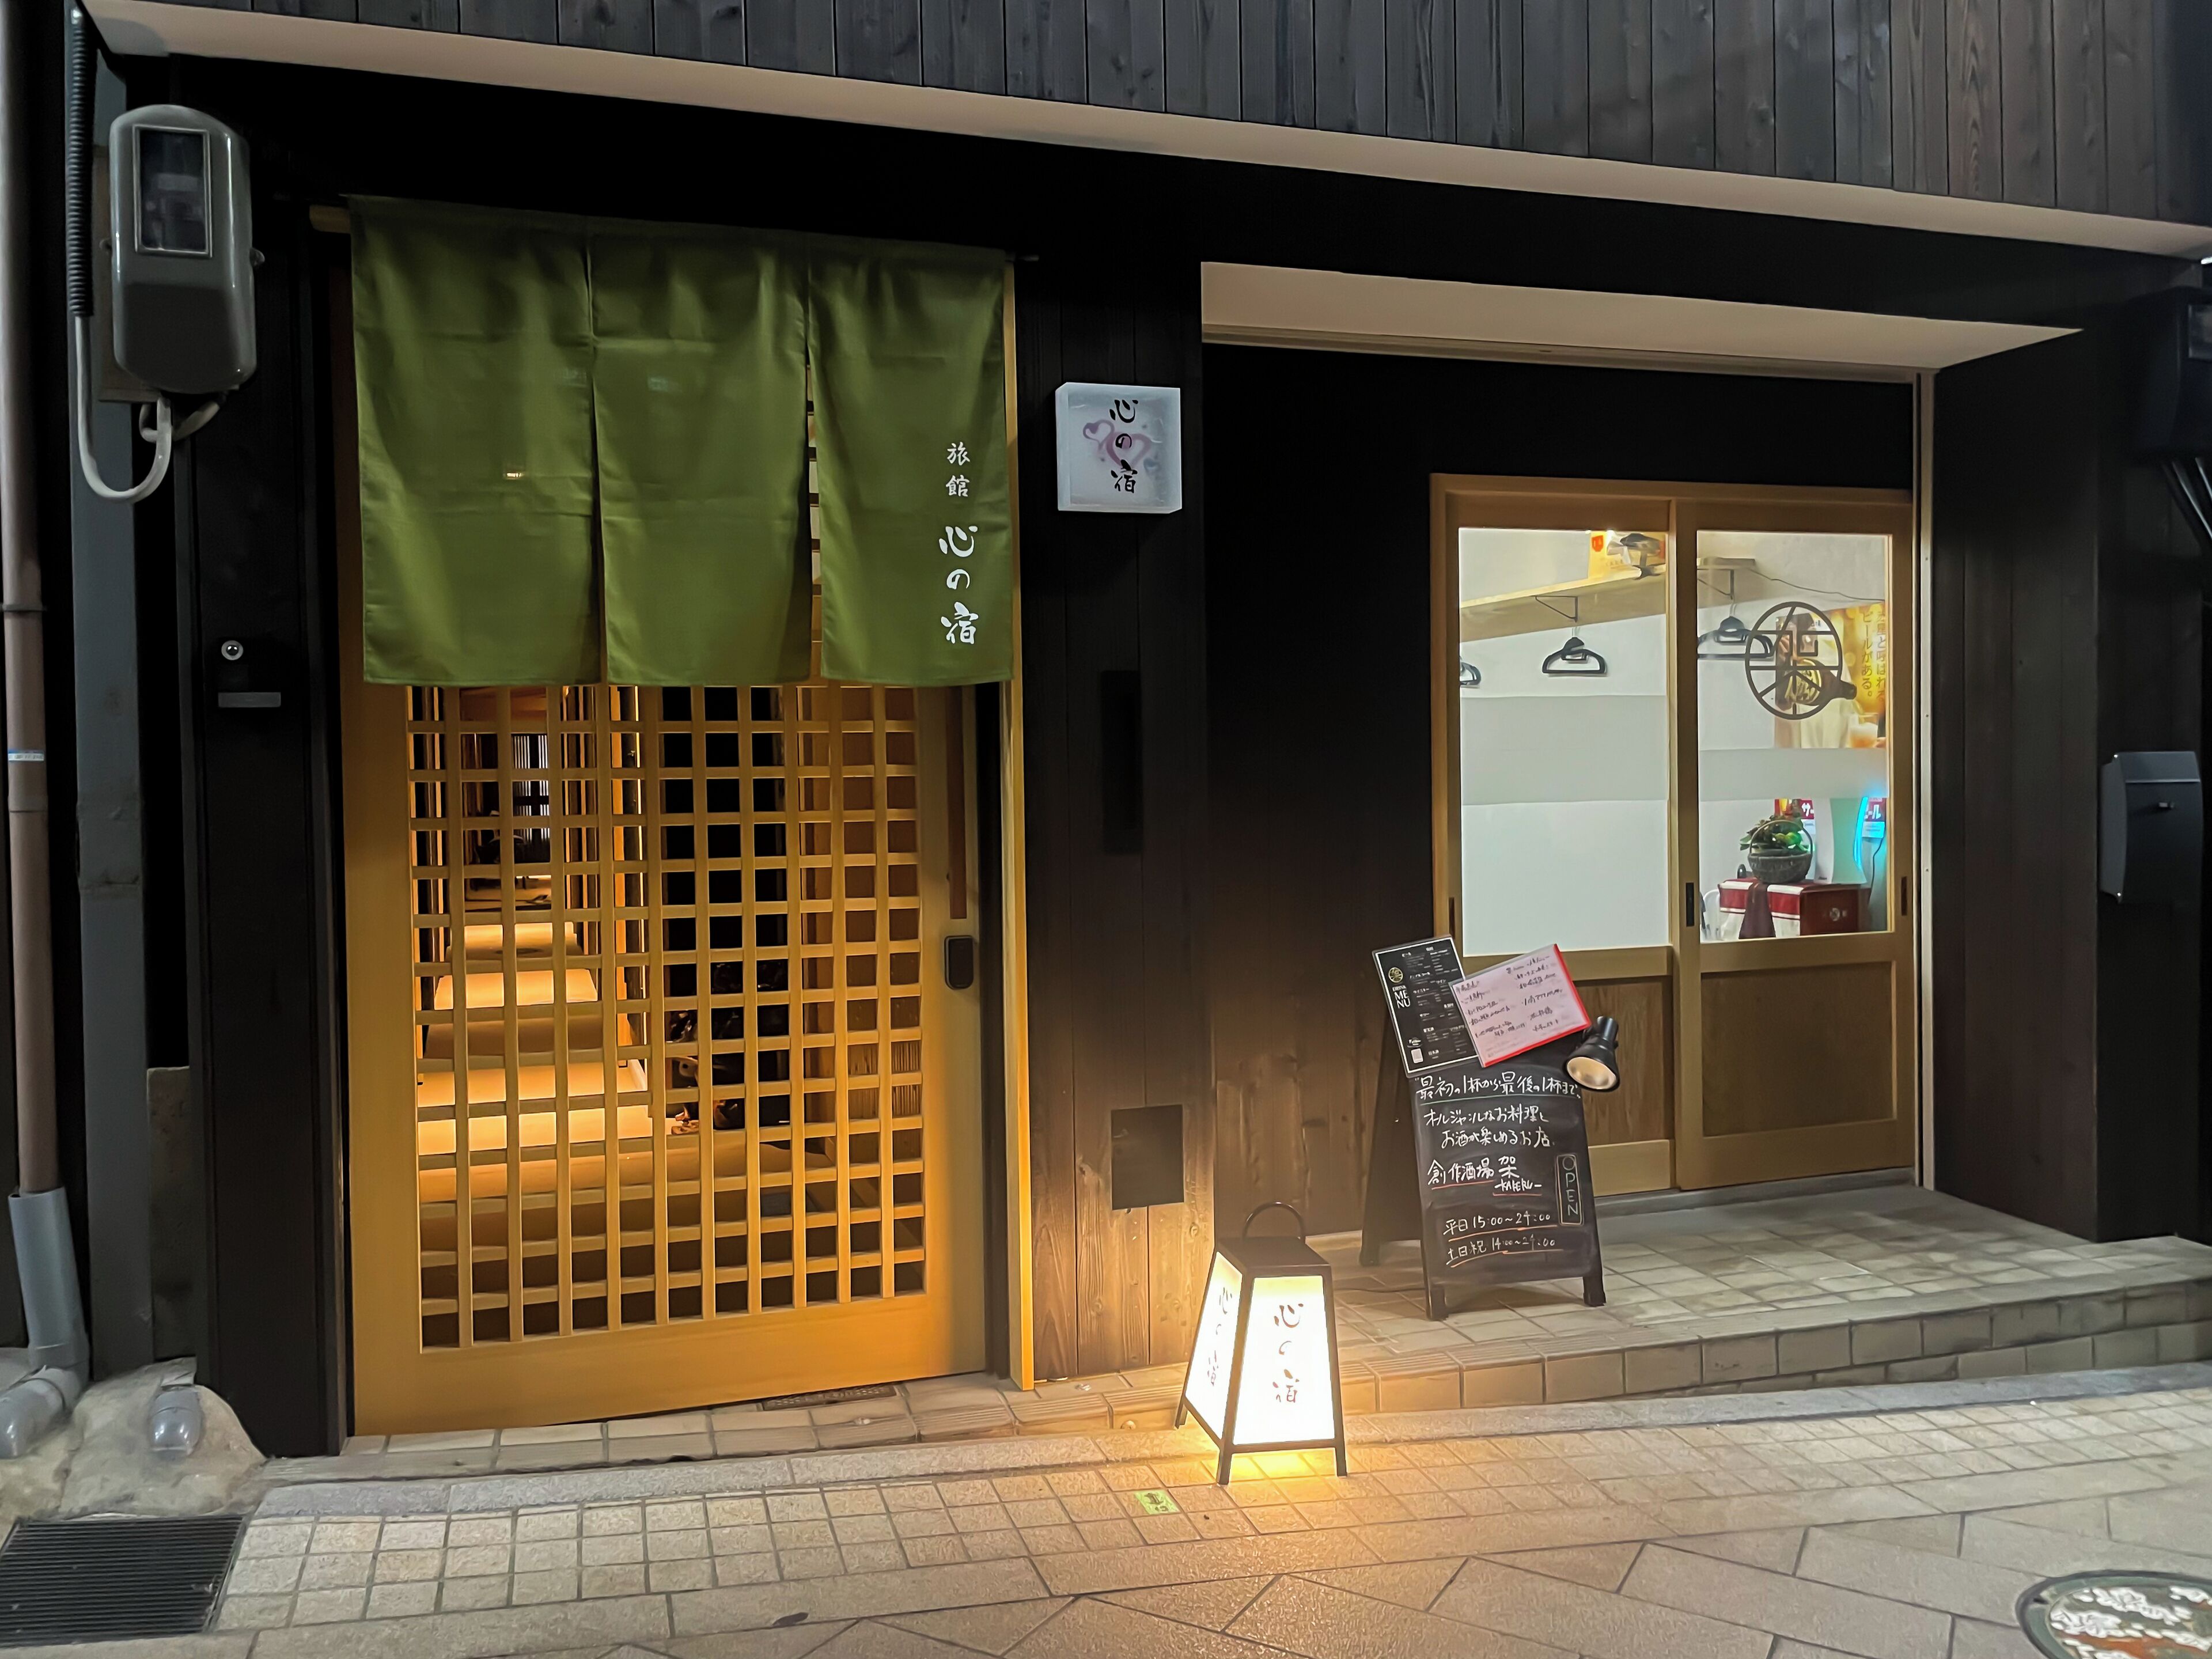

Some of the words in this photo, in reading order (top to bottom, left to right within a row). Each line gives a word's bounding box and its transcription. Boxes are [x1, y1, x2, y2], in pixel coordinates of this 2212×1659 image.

[946, 441, 970, 497] 旅館
[1109, 399, 1138, 493] 心の宿
[939, 525, 979, 644] 心の宿
[1562, 1156, 1579, 1216] OPEN
[1443, 1218, 1468, 1235] 平日
[1446, 1240, 1487, 1265] 土日祝
[1272, 1303, 1304, 1403] 心の宿
